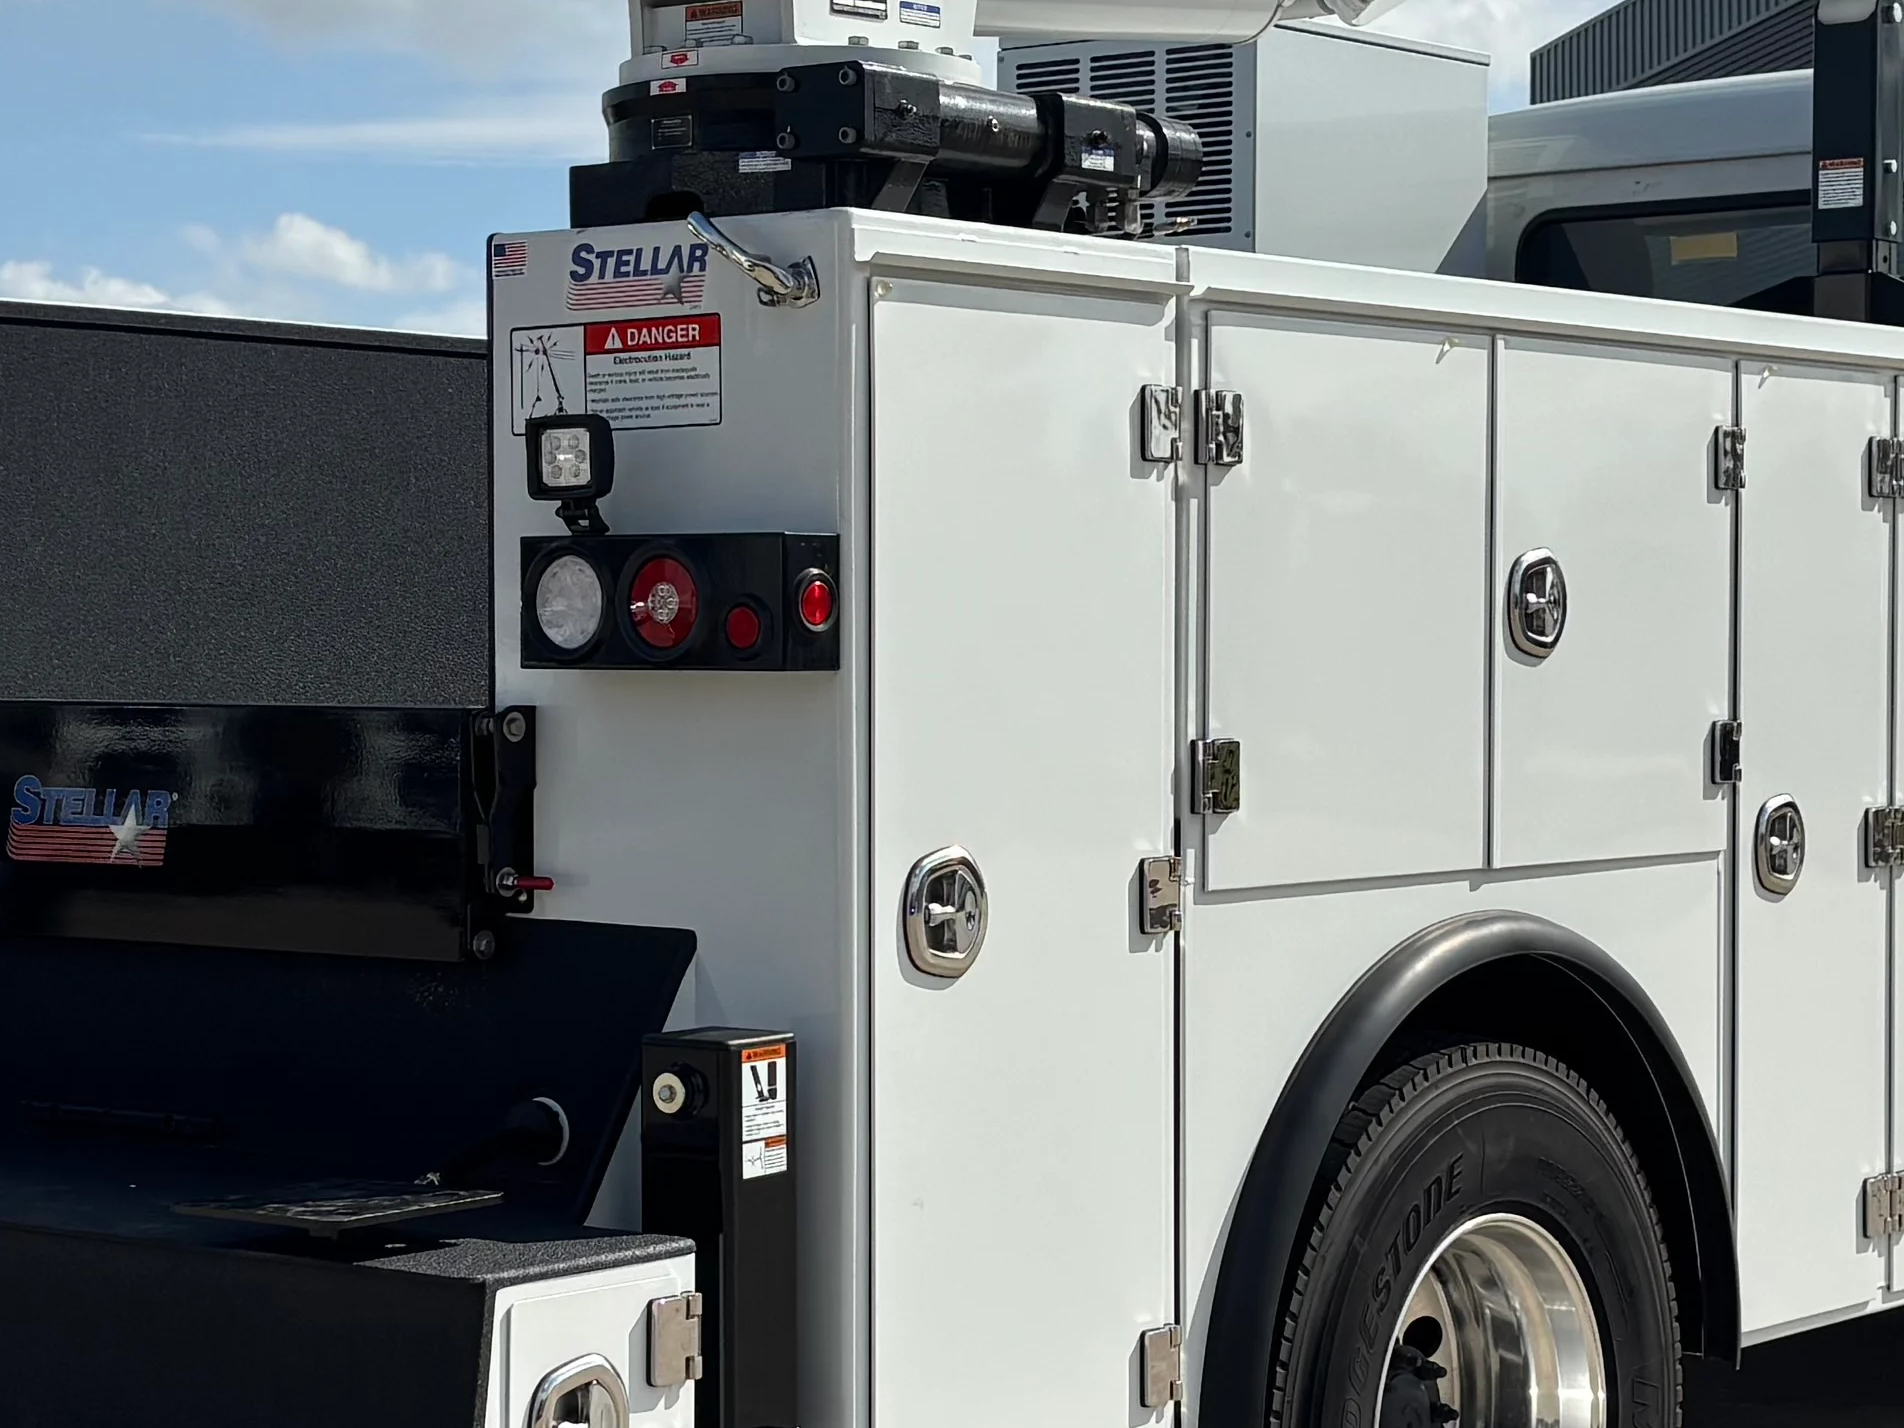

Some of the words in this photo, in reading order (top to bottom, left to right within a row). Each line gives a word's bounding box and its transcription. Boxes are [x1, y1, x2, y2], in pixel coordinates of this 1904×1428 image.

[569, 242, 709, 283] STELLAR
[627, 323, 700, 346] DANGER
[664, 351, 692, 362] Hazard
[10, 774, 172, 829] STELLAR
